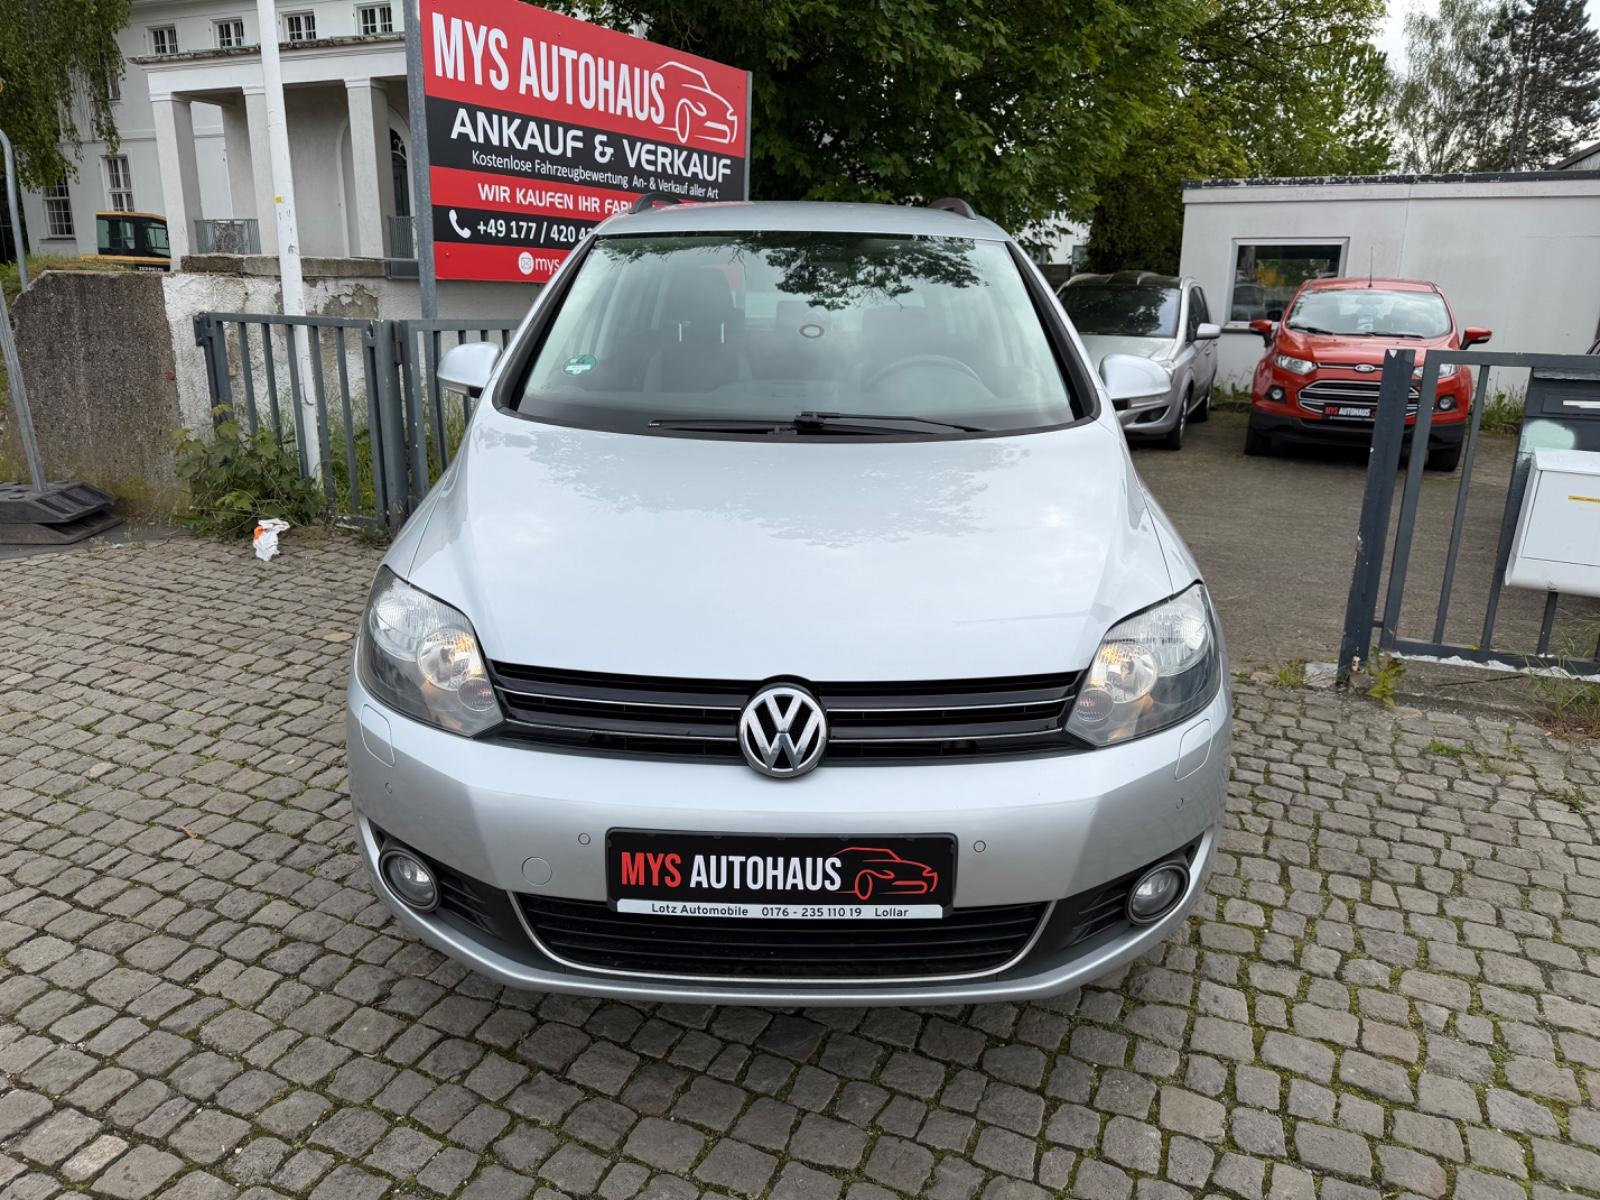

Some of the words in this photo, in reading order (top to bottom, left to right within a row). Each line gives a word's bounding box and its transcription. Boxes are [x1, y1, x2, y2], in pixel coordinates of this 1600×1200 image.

[431, 11, 510, 92] MYS
[518, 36, 666, 126] AUTOHAUS
[450, 107, 585, 158] ANKAUF
[594, 134, 615, 164] &
[622, 138, 733, 184] VERKAUF
[472, 149, 533, 173] Kostenlose
[535, 159, 628, 189] Fahrzeugbewertung
[632, 174, 648, 189] An-
[648, 176, 657, 191] &
[657, 179, 689, 195] Verkauf
[688, 184, 707, 198] aller
[706, 186, 720, 200] Art
[477, 183, 512, 204] WIR
[515, 187, 574, 211] KAUFEN
[578, 195, 601, 214] IHR
[477, 218, 507, 239] +49
[510, 220, 537, 240] 177
[540, 221, 548, 244] /
[550, 224, 576, 243] 420
[1339, 407, 1370, 416] AUTOHAUS
[620, 850, 682, 888] MYS
[689, 854, 842, 892] AUTOHAUS
[651, 902, 678, 914] Lotz
[680, 904, 749, 917] Automobile
[761, 906, 790, 918] 0176
[874, 907, 909, 919] Lollar
